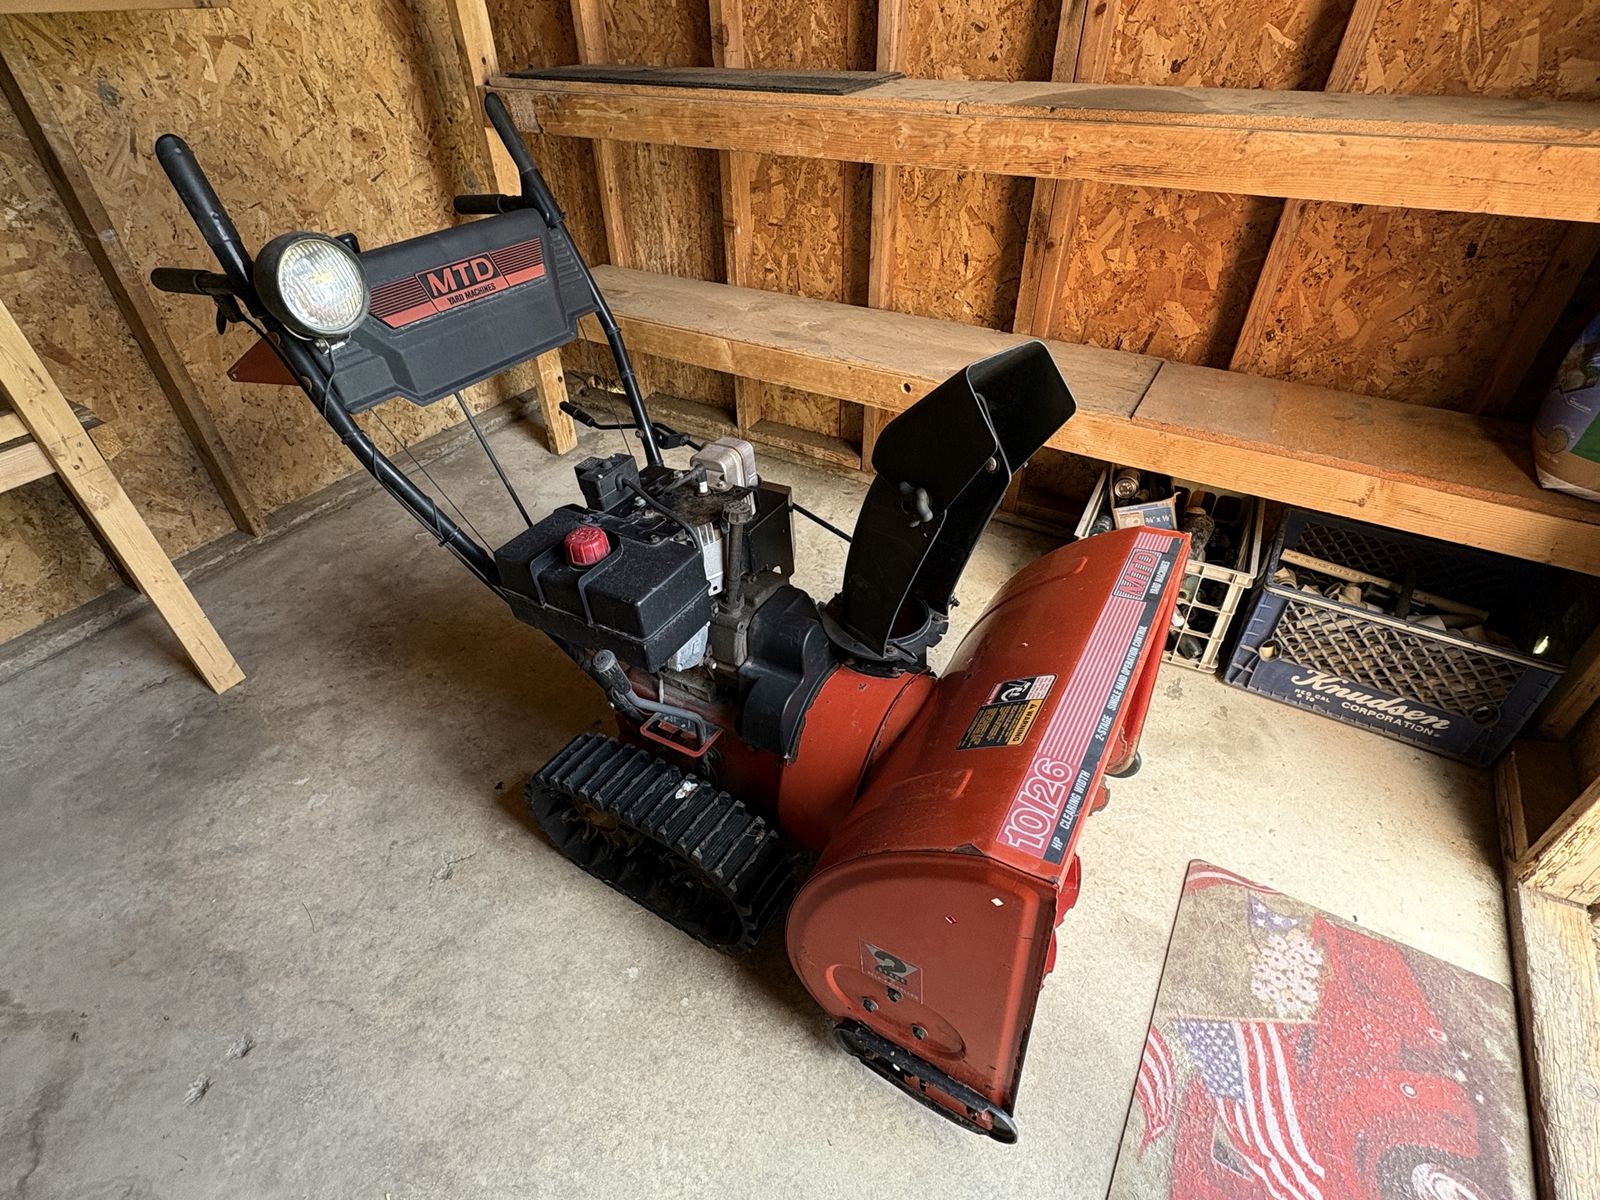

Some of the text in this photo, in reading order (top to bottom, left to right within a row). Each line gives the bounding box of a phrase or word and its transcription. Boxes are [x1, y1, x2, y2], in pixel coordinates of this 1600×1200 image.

[426, 257, 494, 296] MTD
[447, 283, 496, 305] YARD MACHINES
[1119, 552, 1157, 597] MTD
[1121, 646, 1139, 676] OPERATION
[1115, 674, 1128, 692] HAND
[1107, 689, 1122, 711] SINGLE
[1291, 669, 1450, 730] Knudsen
[1012, 711, 1034, 742] WARNING
[1095, 714, 1113, 741] 2-STAGE
[1341, 702, 1434, 736] CORPORATION
[1074, 769, 1091, 795] WIDTH
[1004, 757, 1073, 849] 10/26
[1060, 793, 1081, 830] CLEARING
[1051, 836, 1063, 851] HP
